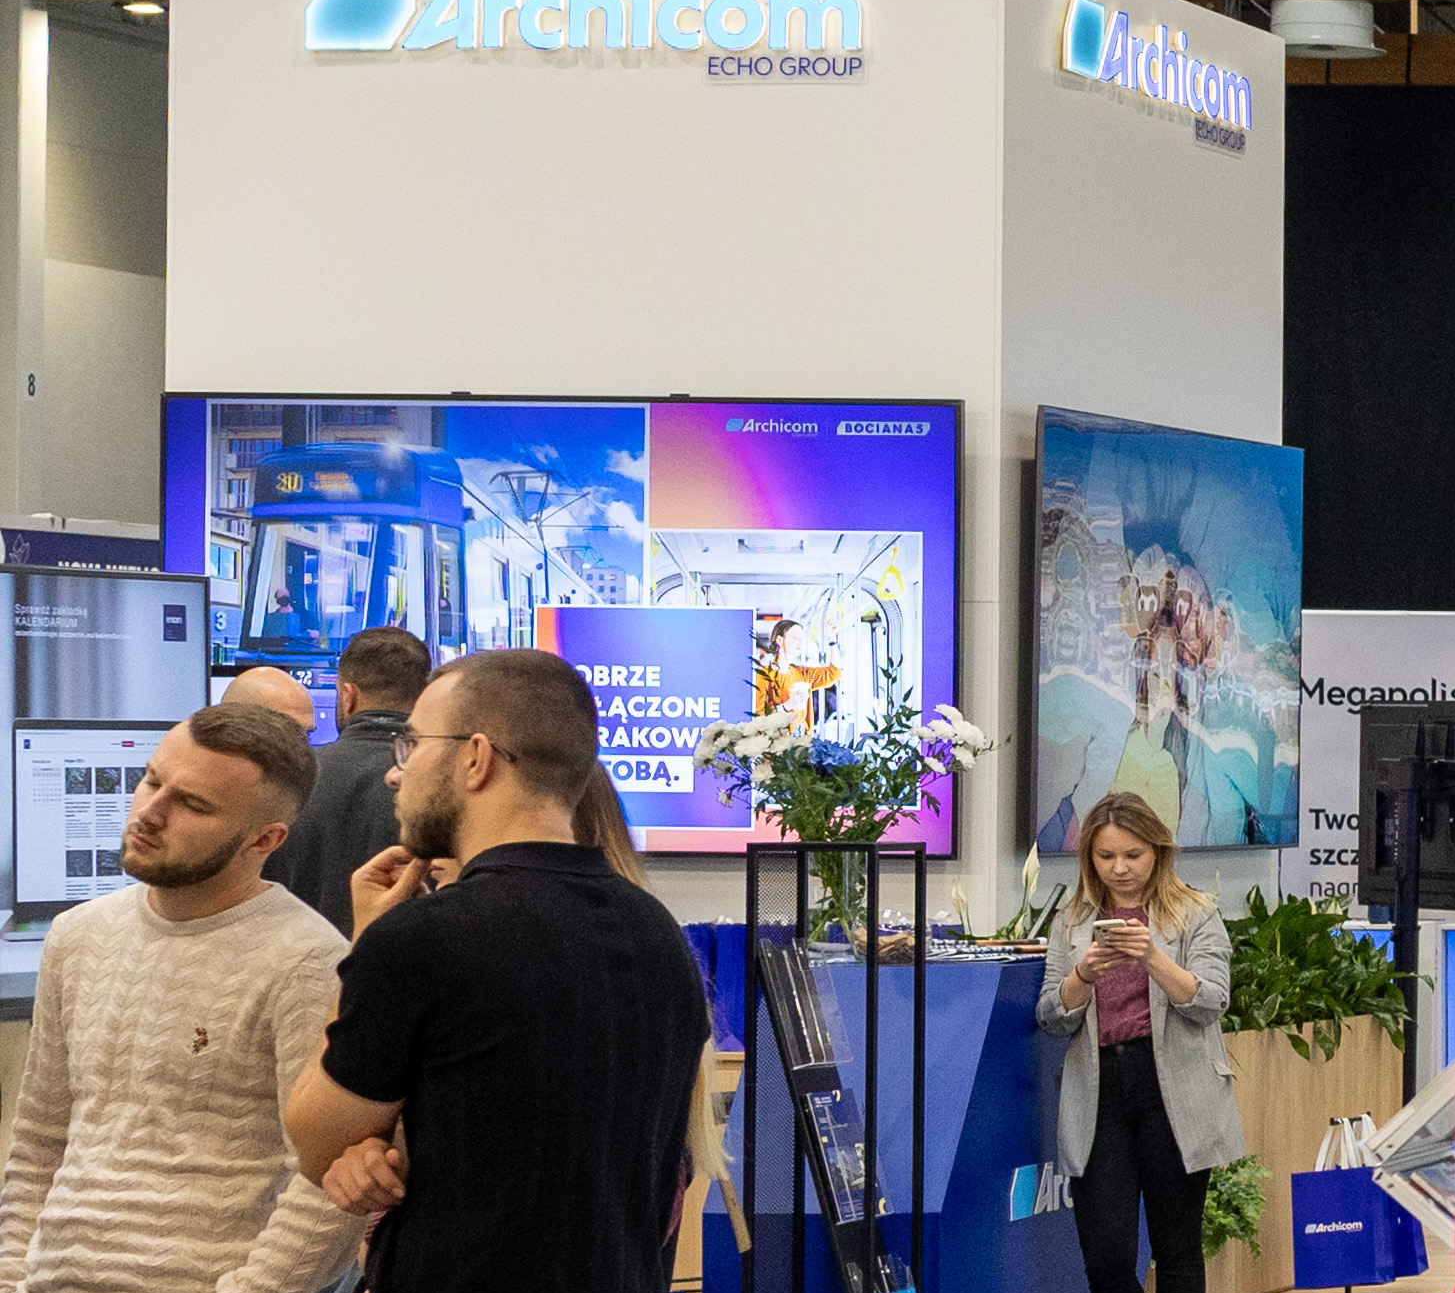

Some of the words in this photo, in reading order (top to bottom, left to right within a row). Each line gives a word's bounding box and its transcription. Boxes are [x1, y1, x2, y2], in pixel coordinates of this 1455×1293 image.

[707, 55, 773, 78] ECHO
[779, 55, 863, 78] GROUP
[1098, 9, 1253, 131] Archicom
[28, 373, 36, 396] 8
[742, 418, 818, 433] Archicom
[575, 664, 662, 687] OBRZE
[594, 695, 721, 724] ŁĄCZONE
[1309, 808, 1360, 831] Two
[1315, 1218, 1364, 1234] Archicom
